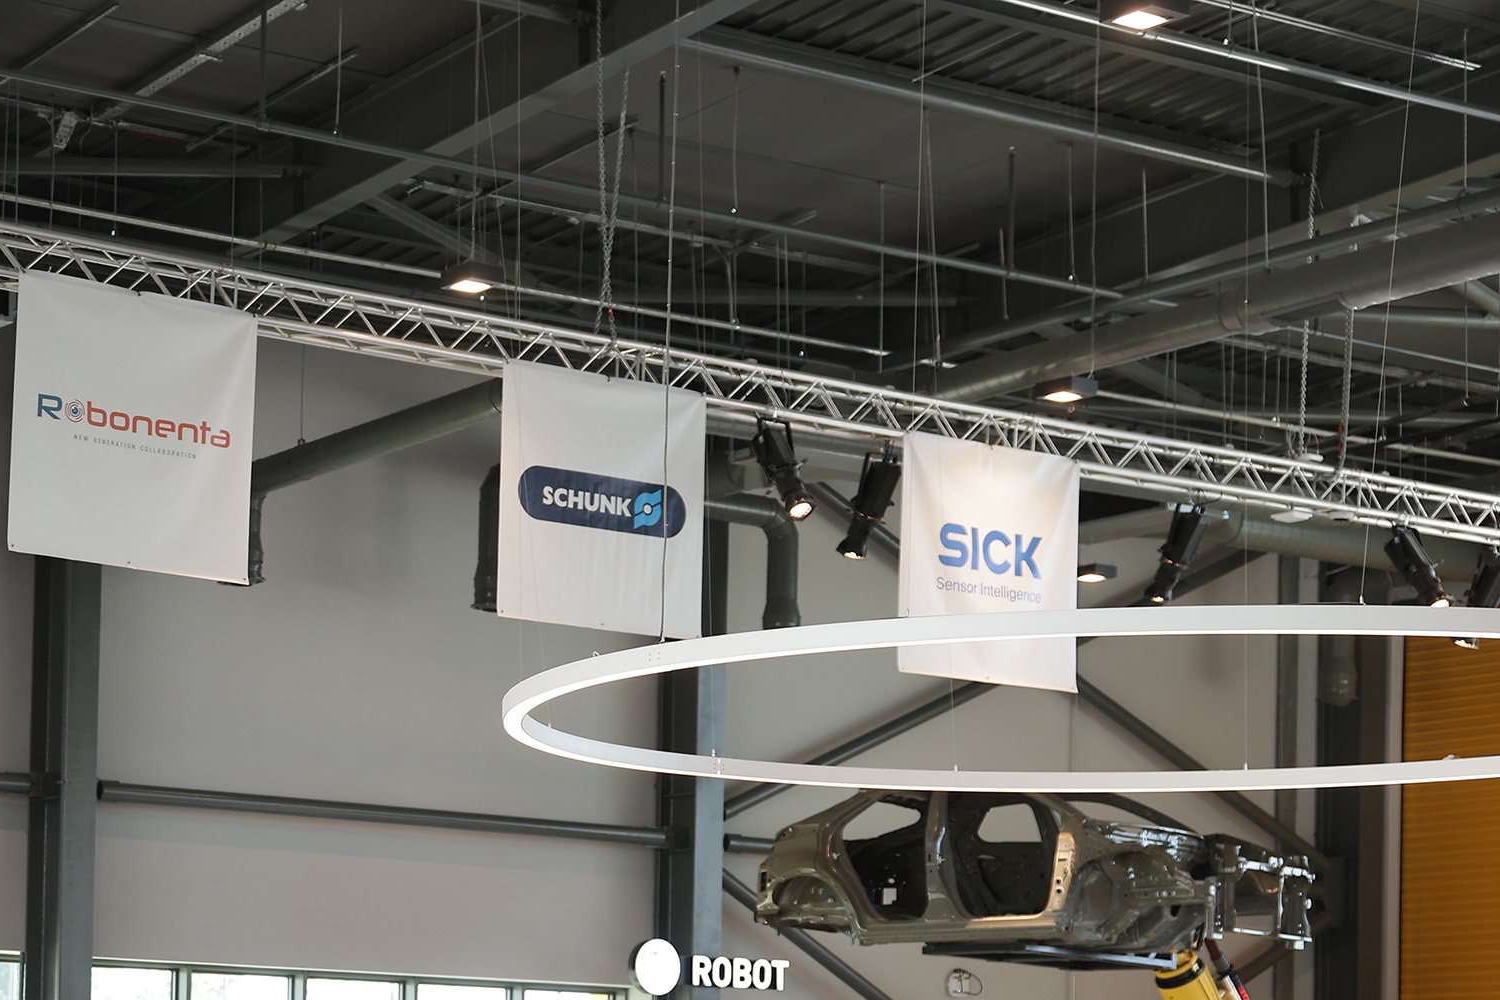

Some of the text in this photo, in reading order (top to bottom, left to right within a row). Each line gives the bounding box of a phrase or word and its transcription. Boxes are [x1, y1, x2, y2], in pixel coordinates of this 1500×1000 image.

[73, 434, 197, 460] NEW GENERATION COLLABORATION
[542, 485, 632, 517] SCHUNK
[938, 522, 1043, 579] SICK
[936, 576, 1042, 604] Sensor Intelligence
[692, 954, 790, 992] ROBOT
